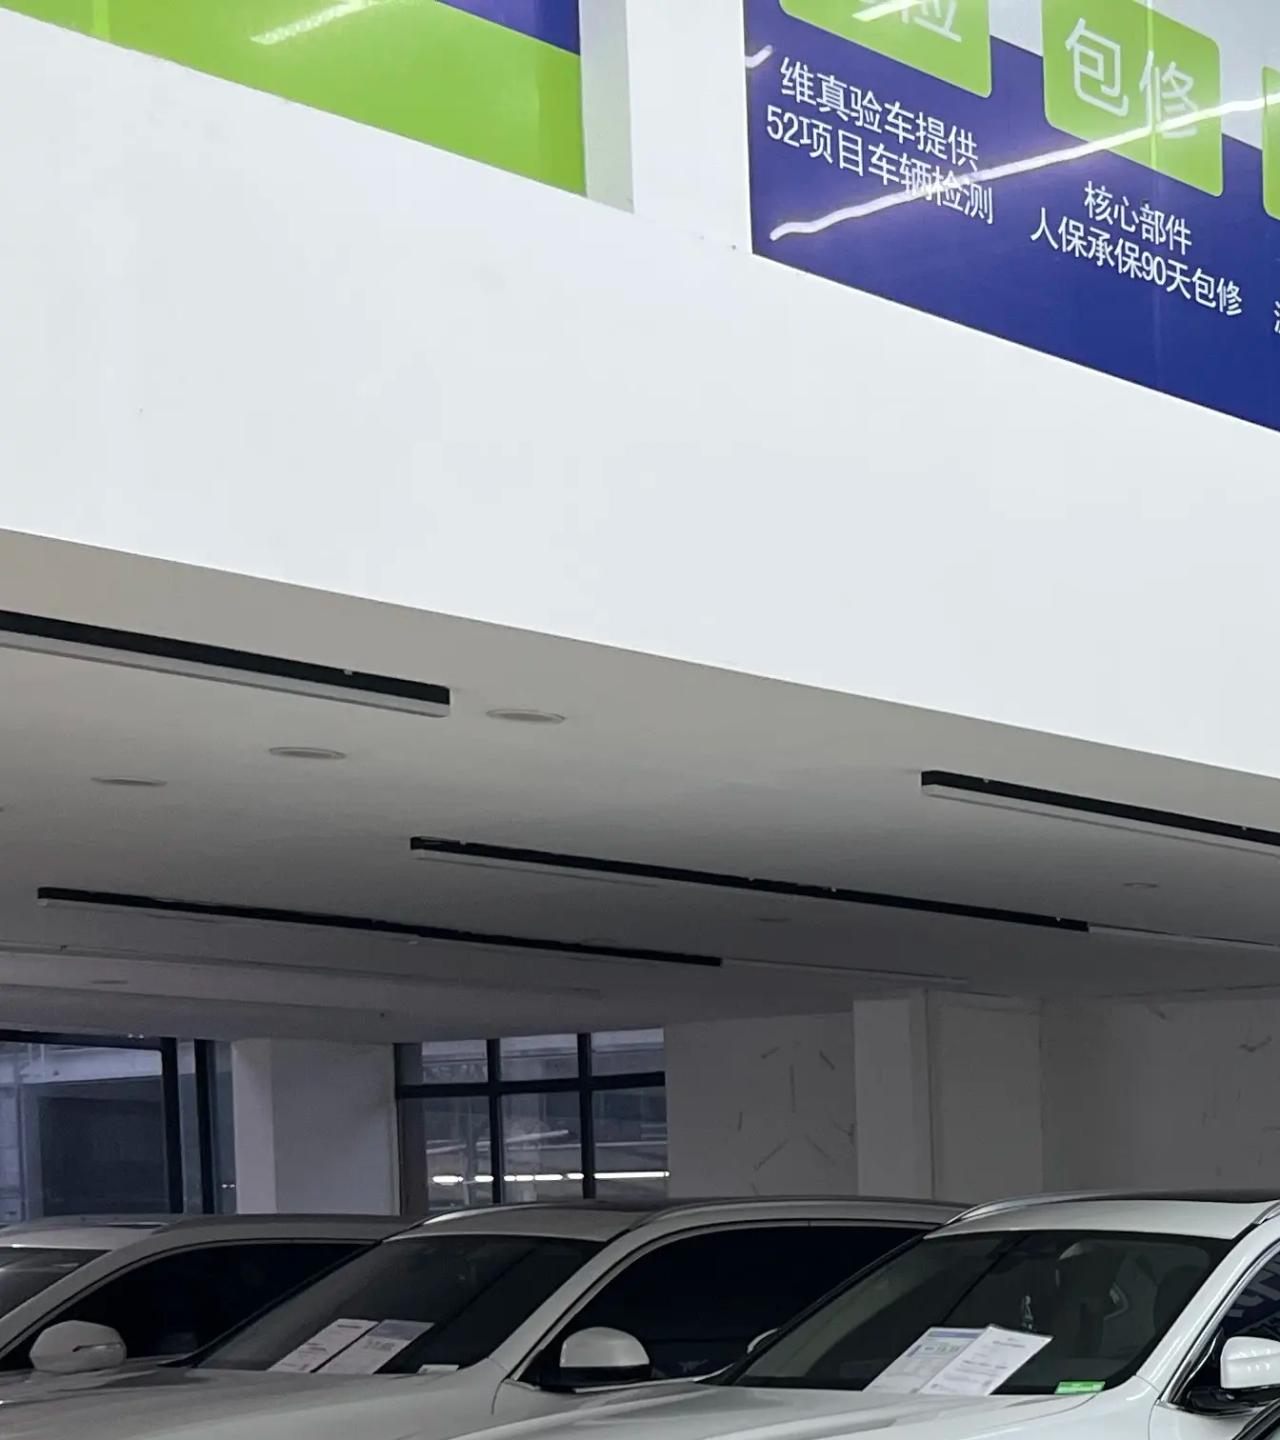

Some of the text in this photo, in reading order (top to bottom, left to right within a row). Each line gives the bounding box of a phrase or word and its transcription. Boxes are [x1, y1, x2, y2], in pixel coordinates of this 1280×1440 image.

[779, 56, 979, 173] 维真验车提供
[1064, 17, 1201, 139] 包修
[766, 104, 994, 225] 52项目车辆检测
[1083, 180, 1193, 256] 核心部件
[1029, 206, 1243, 317] 人保承保90天包修
